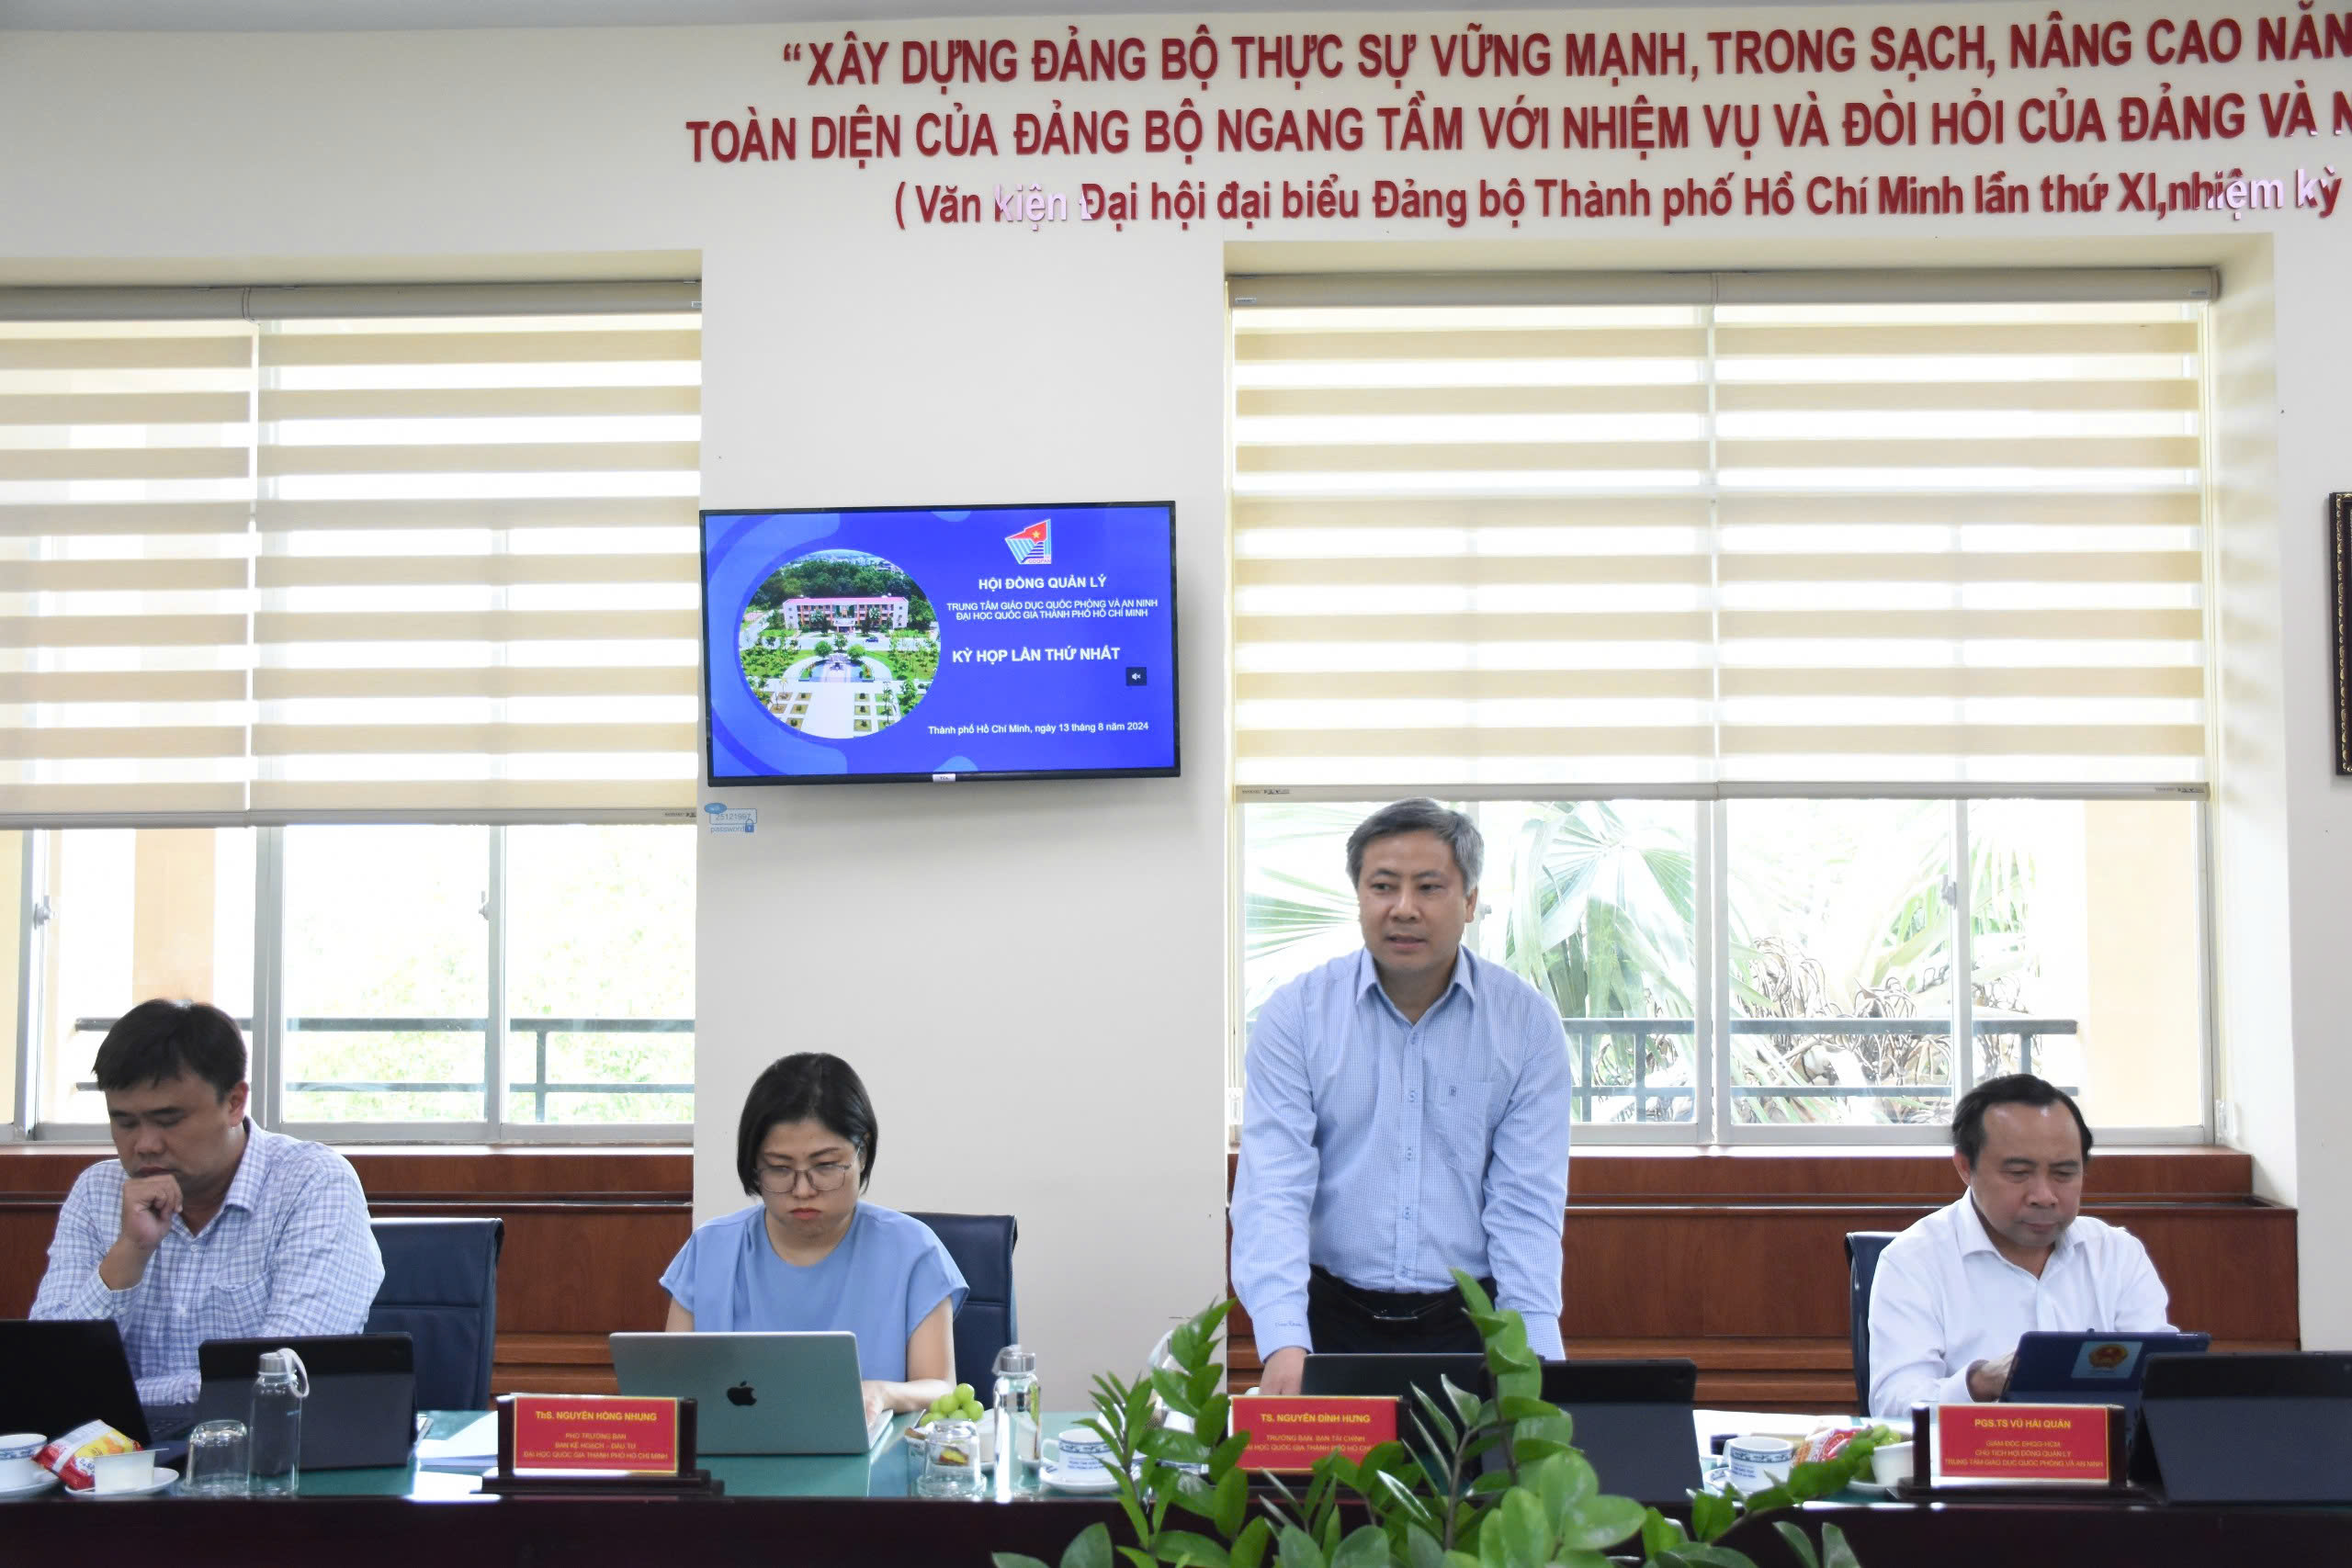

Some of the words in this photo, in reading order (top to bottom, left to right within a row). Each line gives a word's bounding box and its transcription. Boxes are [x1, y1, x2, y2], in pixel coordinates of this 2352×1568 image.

[903, 39, 1017, 95] DỰNG
[1032, 26, 1146, 81] ĐẢNG
[1161, 26, 1217, 90] BỘ
[1232, 34, 1343, 90] THỰC
[1359, 34, 1417, 88] SỰ
[1430, 24, 1551, 76] VỮNG
[1566, 33, 1698, 85] MẠNH,
[1708, 28, 1855, 73] TRONG
[1871, 26, 1995, 81] SẠCH,
[2011, 11, 2132, 66] NÂNG
[2148, 19, 2242, 63] CAO
[687, 107, 796, 162] TOÀN
[812, 105, 900, 169] DIỆN
[917, 103, 998, 155] CỦA
[1014, 99, 1128, 154] ĐẢNG
[1146, 99, 1203, 164] BỘ
[1217, 107, 1363, 152] NGANG
[1377, 90, 1463, 150] TẦM
[1479, 96, 1548, 150] VỚI
[1564, 96, 1688, 159] NHIỆM
[1703, 105, 1759, 159] VỤ
[1773, 92, 1829, 147] VÀ
[1843, 89, 1916, 145] ĐÒI
[1933, 88, 2003, 144] HỎI
[2018, 88, 2106, 142] CỦA
[2120, 83, 2245, 141] ĐẢNG
[2260, 81, 2316, 137] VÀ
[994, 184, 1066, 230] kiện
[1080, 183, 1136, 231] Đại
[1151, 180, 1205, 230] hội
[1217, 181, 1270, 228] đại
[1283, 174, 1358, 218] biểu
[1373, 179, 1466, 228] Đảng
[1479, 179, 1525, 228] bộ
[1535, 179, 1650, 218] Thành
[1664, 173, 1734, 225] phố
[1745, 172, 1793, 215] Hồ
[1807, 176, 1867, 215] Chí
[1879, 176, 1963, 213] Minh
[1975, 172, 2029, 213] lần
[2041, 174, 2109, 211] thứ
[2298, 169, 2342, 218] kỳ
[978, 577, 1001, 592] HỘI
[1005, 576, 1045, 590] ĐỒNG
[1047, 574, 1086, 589] QUẢN
[1090, 573, 1107, 588] LÝ
[952, 648, 973, 663] KỲ
[977, 649, 1008, 665] HỌP
[1012, 647, 1041, 661] LẦN
[1046, 646, 1078, 661] THỨ
[1080, 645, 1121, 660] NHẤT
[928, 726, 956, 735] Thành
[957, 724, 975, 736] phố
[977, 724, 989, 734] Hồ
[991, 724, 1007, 733] Chí
[1009, 724, 1033, 735] Minh,
[1035, 724, 1057, 735] ngày
[1058, 724, 1069, 732] 13
[1071, 723, 1095, 734] tháng
[1097, 723, 1104, 731] 8
[1106, 722, 1125, 731] năm
[1126, 722, 1148, 731] 2024
[535, 1411, 555, 1419] ThS.
[556, 1411, 594, 1420] NGUYỄN
[595, 1411, 623, 1420] HỒNG
[625, 1412, 657, 1421] NHUNG
[1261, 1413, 1275, 1422] TS.
[1277, 1413, 1316, 1422] NGUYỄN
[1317, 1412, 1340, 1422] ĐÌNH
[1342, 1413, 1371, 1423] HƯNG
